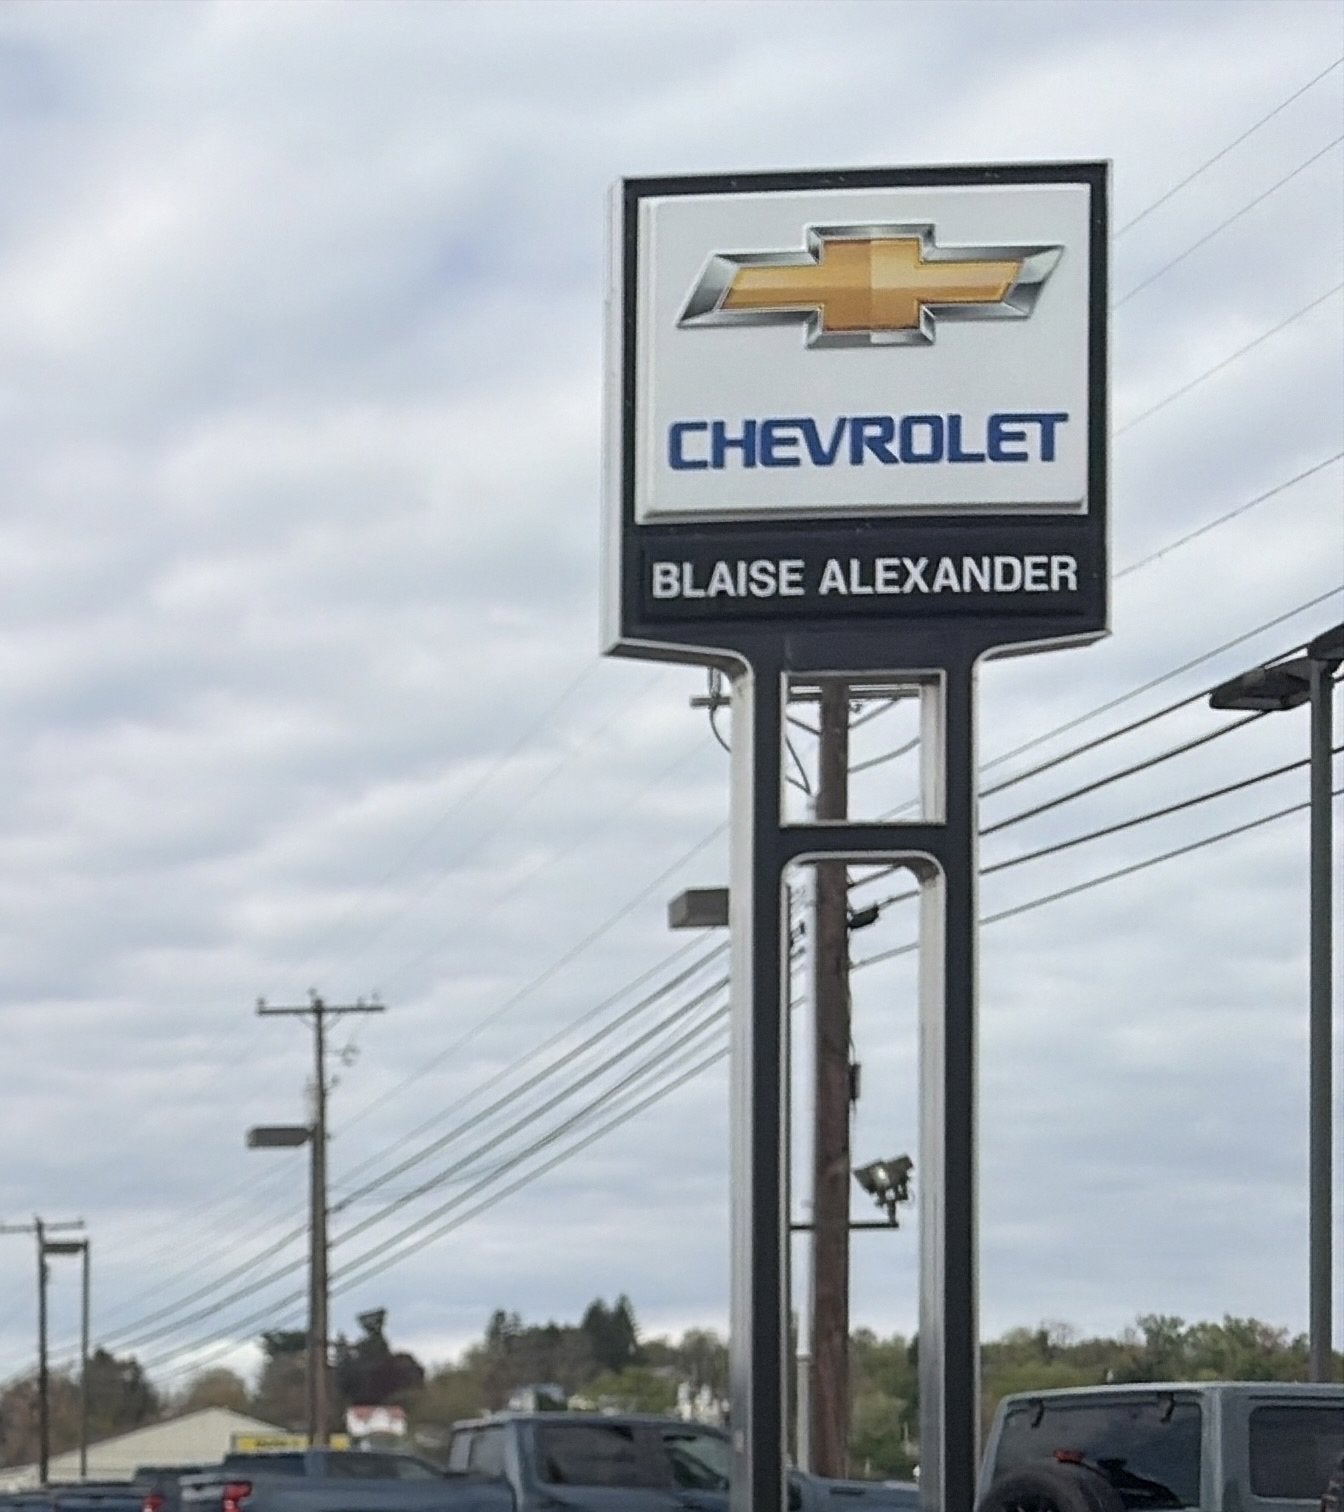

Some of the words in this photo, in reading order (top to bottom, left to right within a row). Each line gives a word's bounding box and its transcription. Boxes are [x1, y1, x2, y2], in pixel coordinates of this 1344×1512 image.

[669, 413, 1069, 470] CHEVROLET
[651, 558, 806, 599] BLAISE
[818, 554, 1078, 595] ALEXANDER
